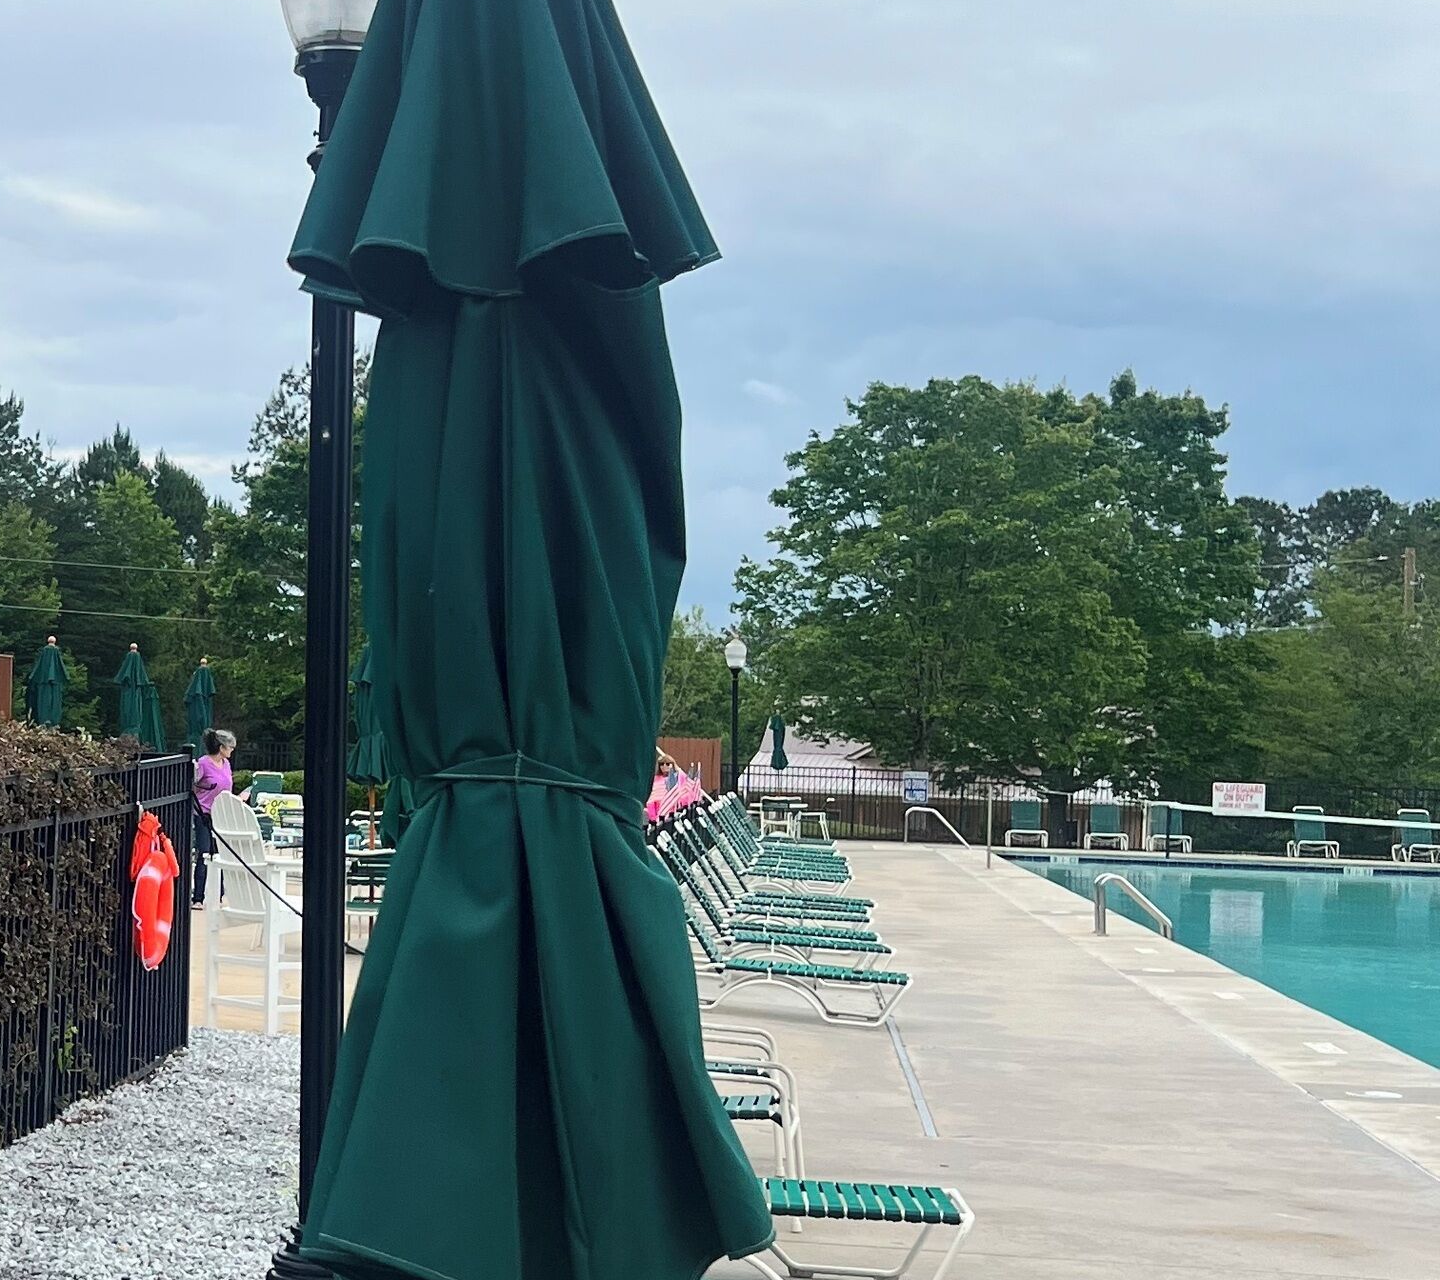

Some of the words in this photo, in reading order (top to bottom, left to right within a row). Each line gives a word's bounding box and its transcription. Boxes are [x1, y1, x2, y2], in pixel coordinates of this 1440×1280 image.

[1215, 784, 1224, 792] NO
[1226, 784, 1264, 793] LIFEGUARD
[1224, 793, 1233, 801] ON
[1236, 793, 1253, 802] DUTY
